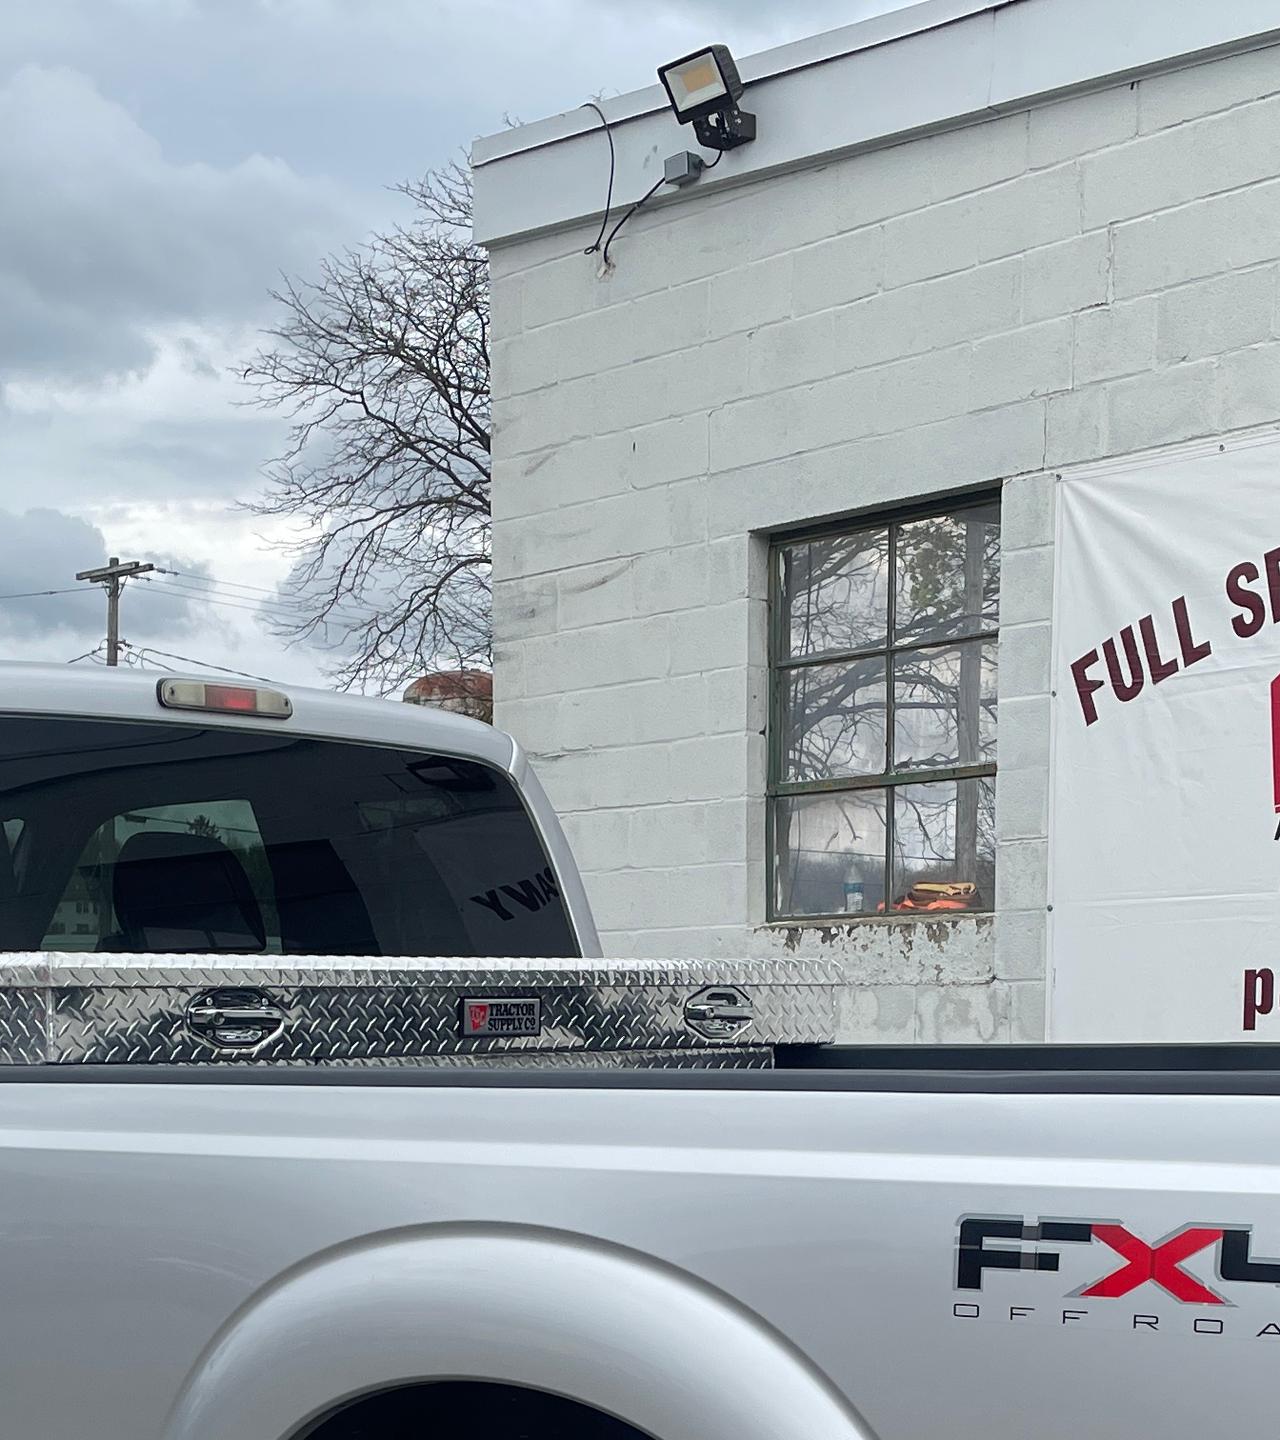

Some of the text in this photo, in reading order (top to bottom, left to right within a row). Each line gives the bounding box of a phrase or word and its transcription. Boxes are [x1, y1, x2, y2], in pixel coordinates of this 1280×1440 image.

[1070, 595, 1212, 727] FULL
[488, 1003, 535, 1017] TRACTOR
[488, 1017, 524, 1031] SUPPLY
